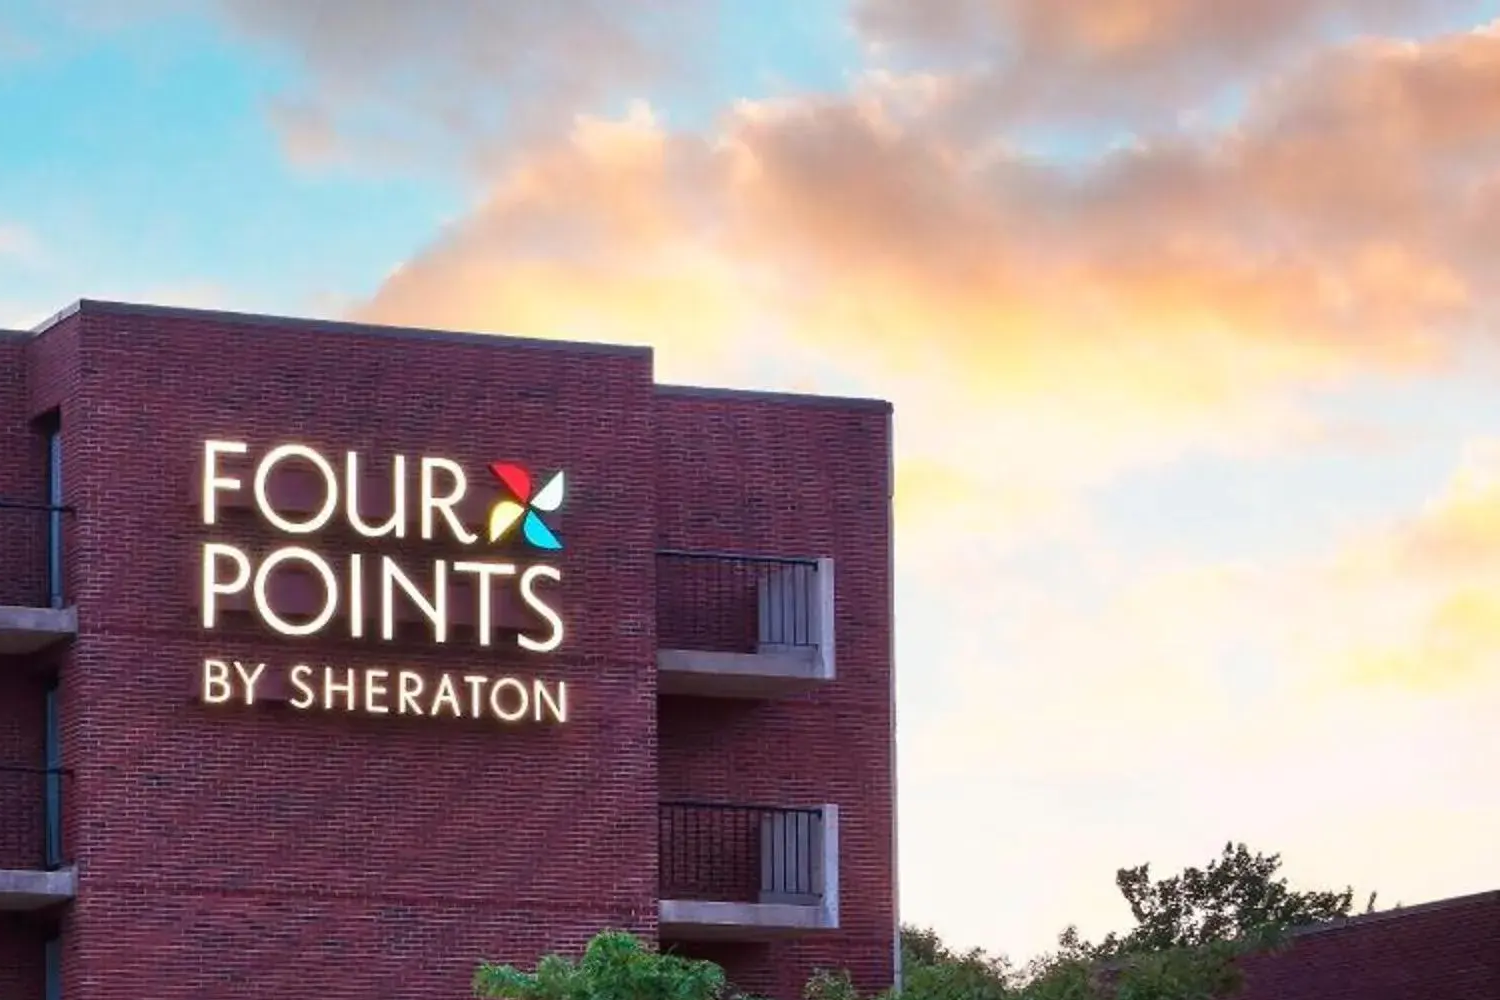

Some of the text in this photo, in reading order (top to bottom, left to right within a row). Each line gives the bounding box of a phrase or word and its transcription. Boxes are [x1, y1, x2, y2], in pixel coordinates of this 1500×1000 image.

[202, 439, 478, 545] FOUR
[202, 543, 565, 653] POINTS
[203, 659, 568, 723] BY SHERATON
